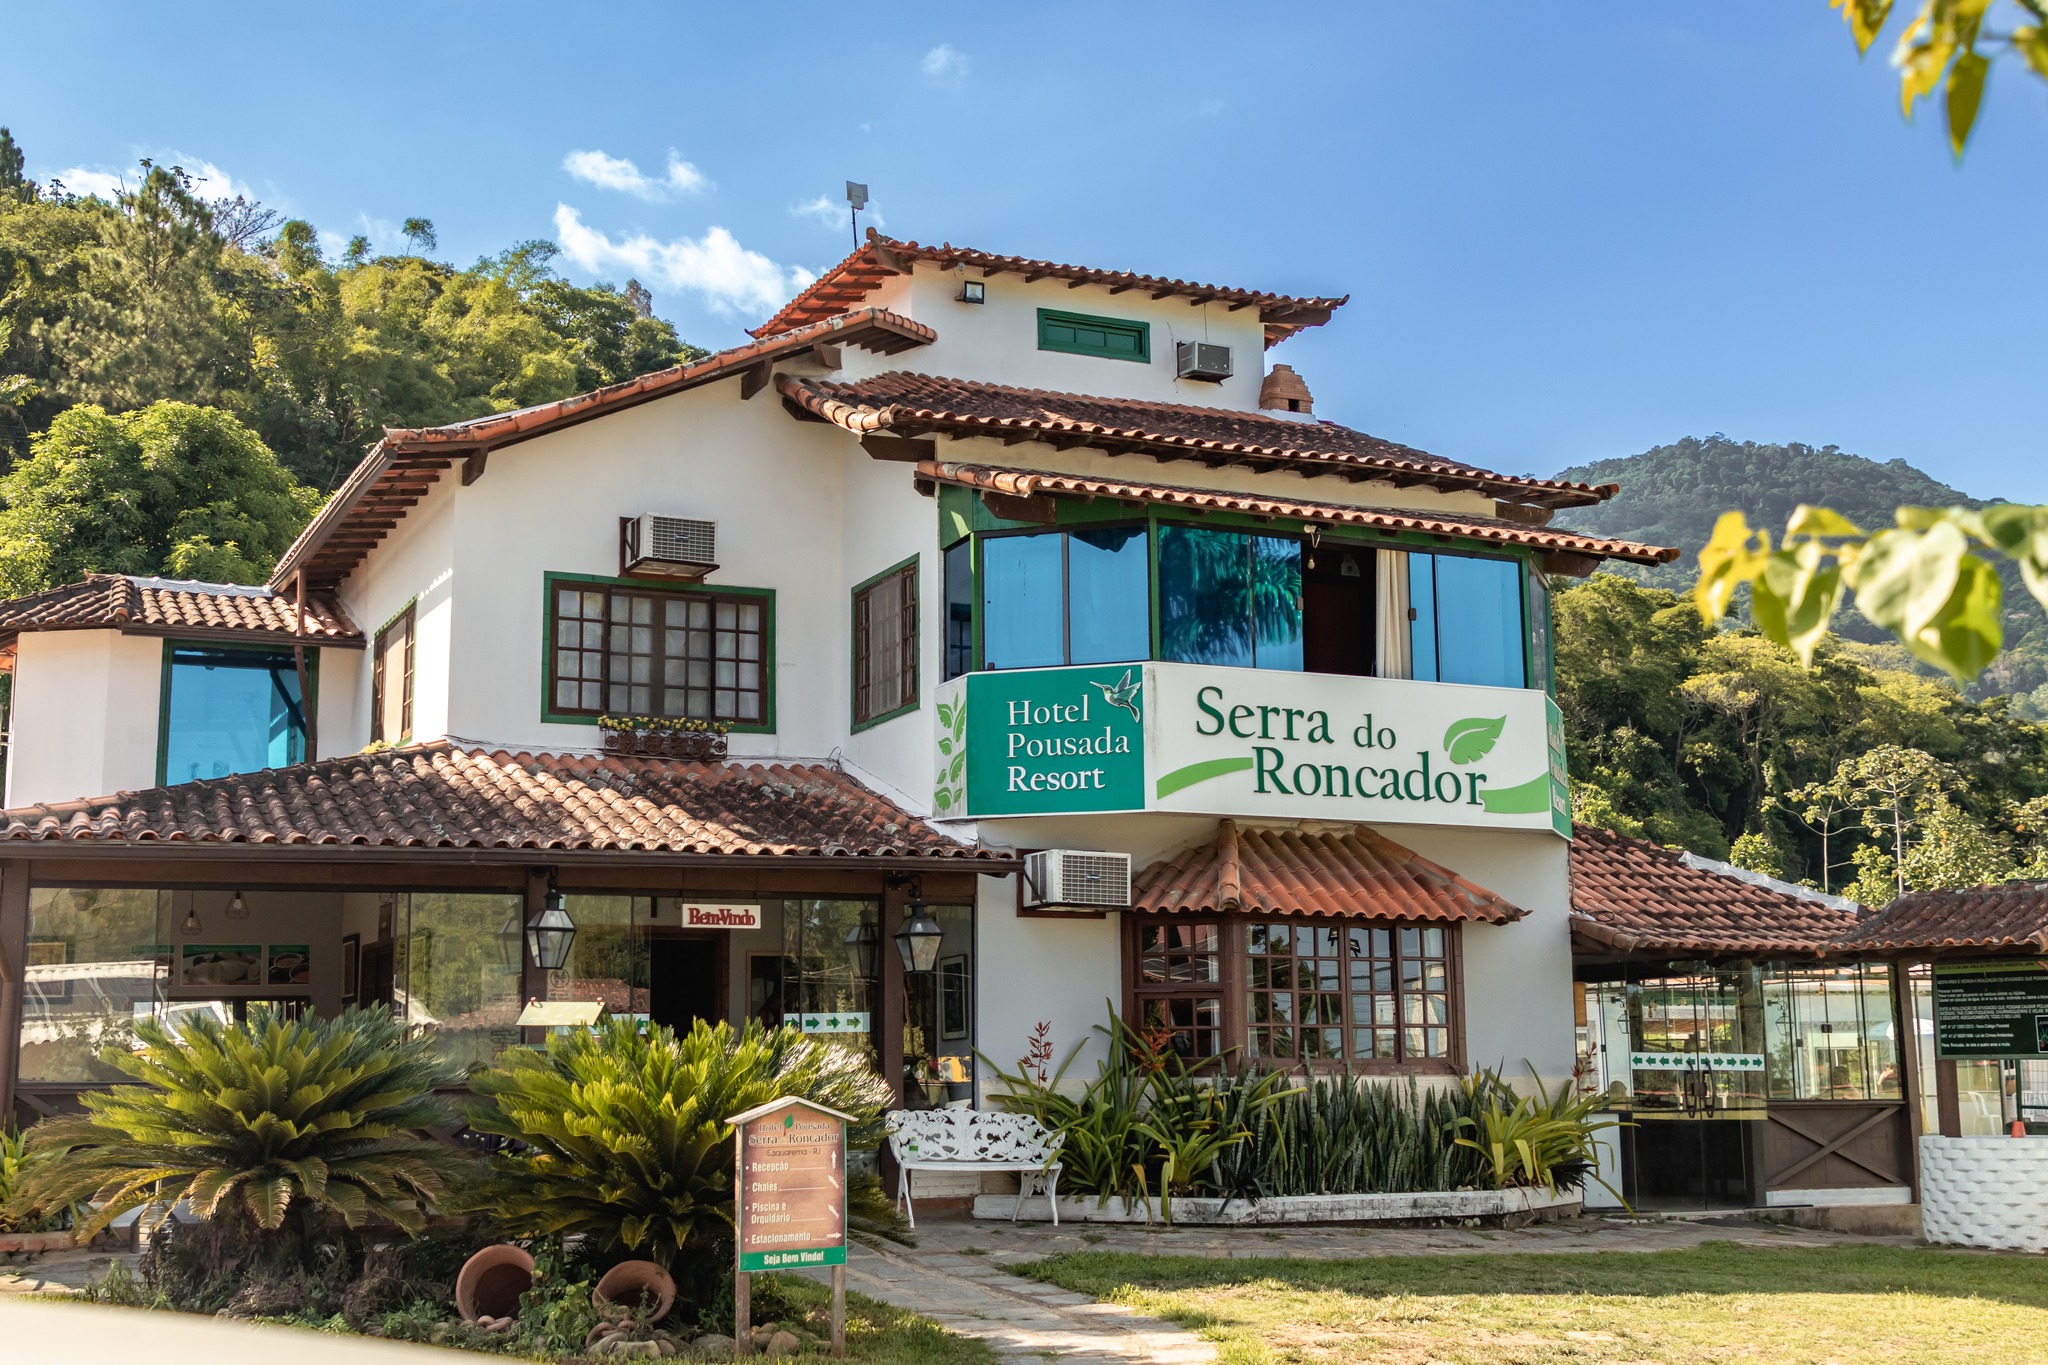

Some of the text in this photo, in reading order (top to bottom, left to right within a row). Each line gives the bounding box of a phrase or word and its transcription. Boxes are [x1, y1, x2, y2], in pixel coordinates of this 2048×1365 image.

[1006, 694, 1091, 726] Hotel
[1196, 686, 1397, 750] Serra do
[1006, 726, 1131, 758] Pousada
[1006, 766, 1106, 792] Resort
[1251, 747, 1488, 806] Roncador
[759, 1120, 830, 1132] Hotel Pousada
[749, 1134, 778, 1146] Serra
[789, 1133, 839, 1143] Roncador
[813, 1147, 822, 1155] RJ
[752, 1161, 789, 1172] Recepção
[752, 1182, 778, 1193] Chalés
[752, 1202, 787, 1213] Piscina e
[751, 1213, 791, 1224] Orquidário
[751, 1231, 811, 1245] Estacionamento
[764, 1251, 824, 1265] Seja Bem Vindo!
